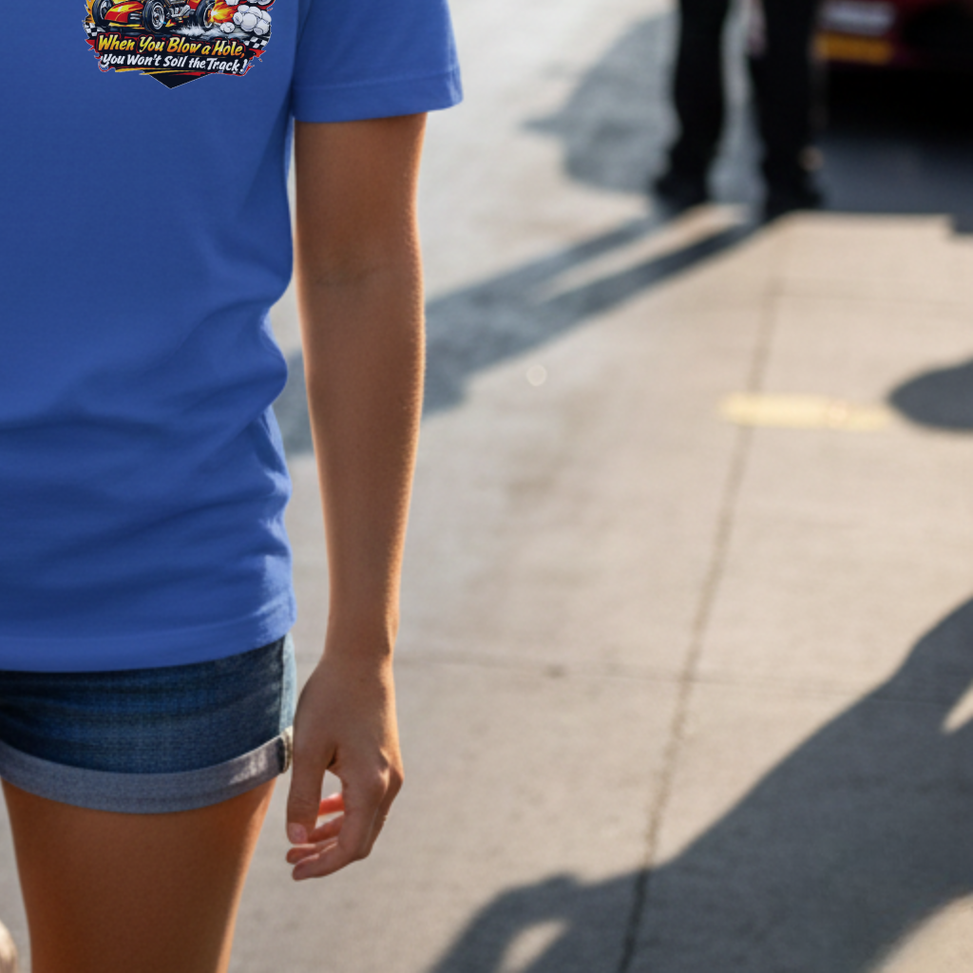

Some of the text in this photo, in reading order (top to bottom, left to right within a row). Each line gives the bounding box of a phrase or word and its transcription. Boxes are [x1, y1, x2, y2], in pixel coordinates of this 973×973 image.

[98, 34, 245, 59] When You Blow a Hole,
[100, 53, 126, 68] You
[127, 53, 163, 66] Won't
[188, 57, 207, 69] the
